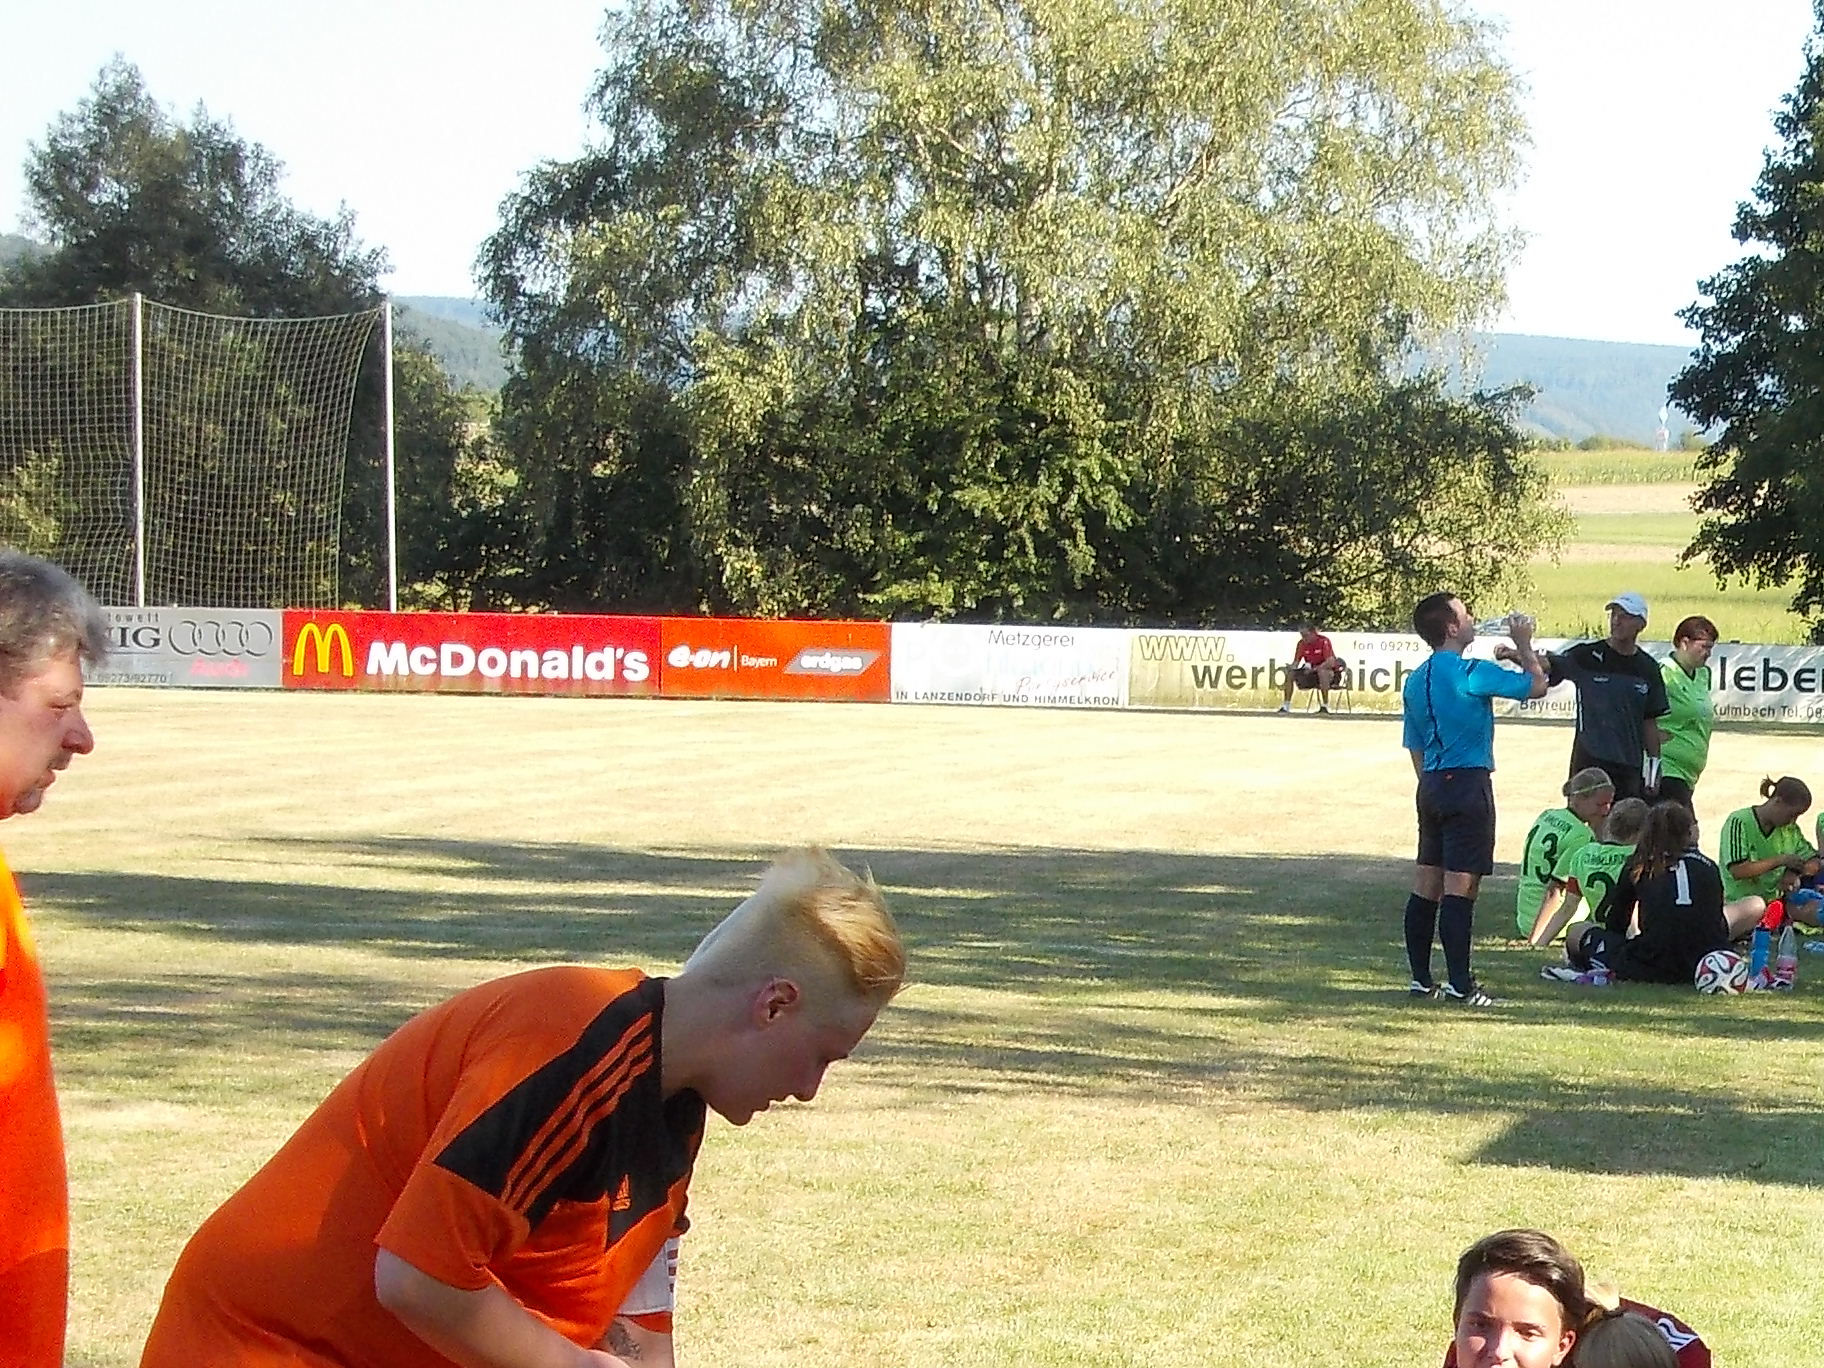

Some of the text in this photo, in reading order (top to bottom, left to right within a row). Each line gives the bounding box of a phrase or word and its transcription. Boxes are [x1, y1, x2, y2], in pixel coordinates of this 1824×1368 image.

[988, 630, 1075, 649] Metzgerei
[1139, 635, 1235, 663] www.
[366, 641, 650, 682] McDonald's
[740, 655, 778, 669] Bayern
[800, 652, 863, 672] erdgas
[895, 690, 1120, 706] IN LANZENDORF UND HIMMELKRON
[1523, 824, 1558, 884] 13
[1669, 859, 1693, 906] 1
